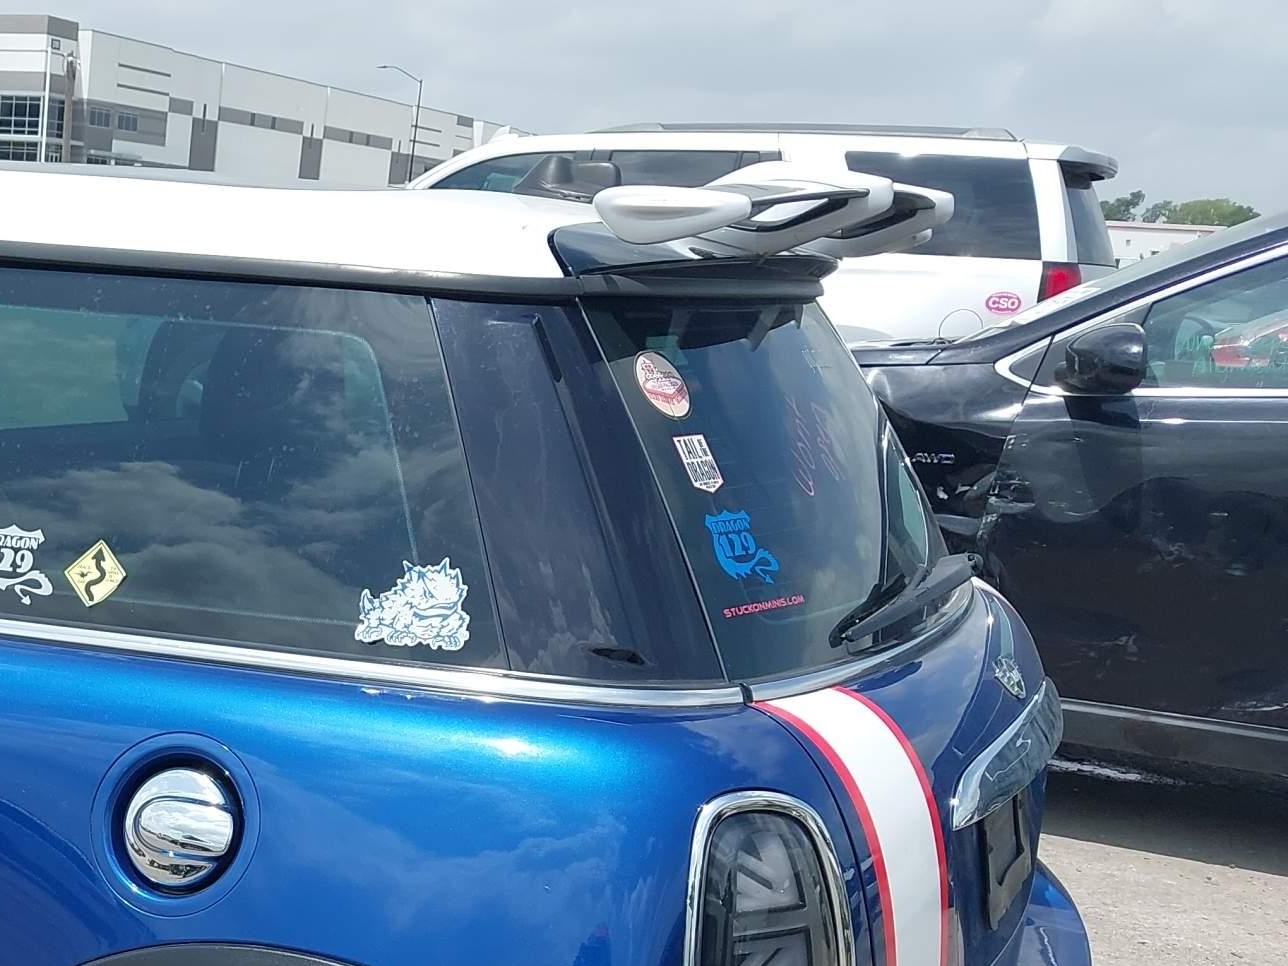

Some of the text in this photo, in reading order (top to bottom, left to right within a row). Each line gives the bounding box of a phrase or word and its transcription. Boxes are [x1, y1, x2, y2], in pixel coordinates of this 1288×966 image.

[987, 296, 1019, 309] CSO
[676, 437, 703, 461] TAIL
[686, 458, 721, 483] DRAGON
[712, 518, 751, 533] DRAGON
[718, 531, 756, 558] 129
